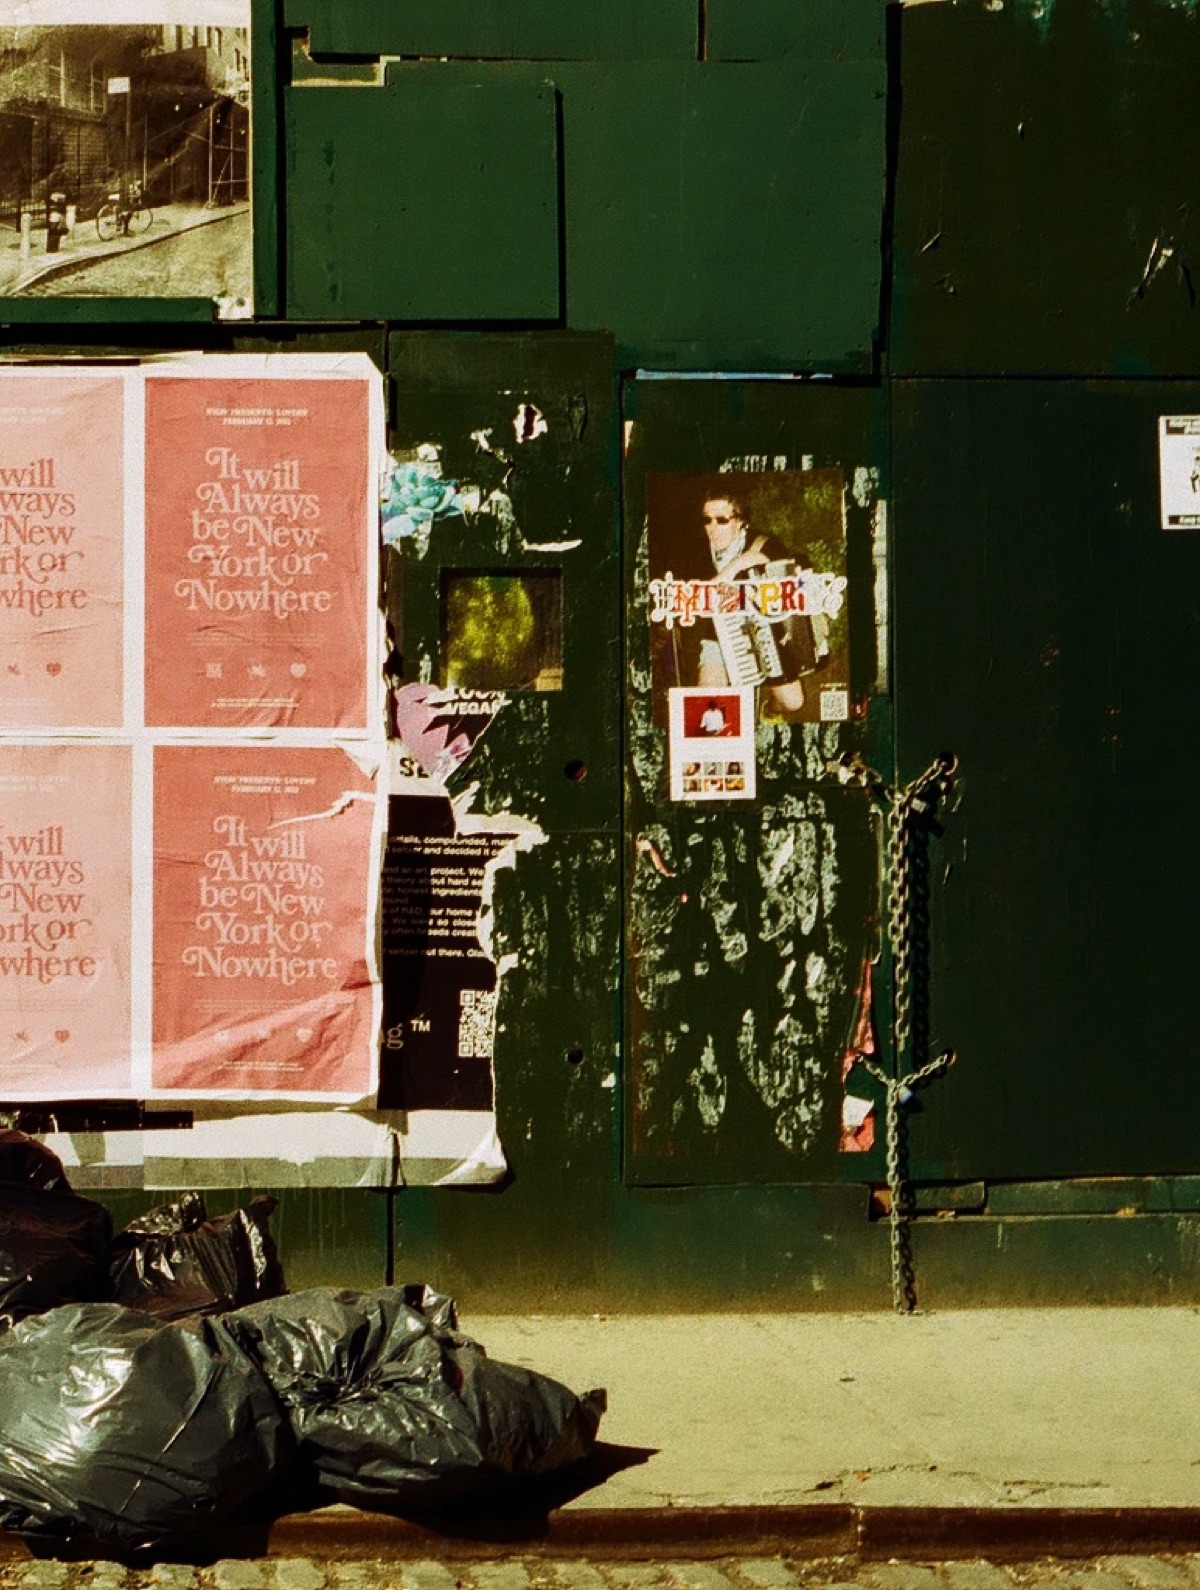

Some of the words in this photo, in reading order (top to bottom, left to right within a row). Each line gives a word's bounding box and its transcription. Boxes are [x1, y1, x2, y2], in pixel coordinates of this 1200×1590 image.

[0, 458, 55, 488] will
[205, 448, 241, 479] It
[243, 459, 301, 490] will
[196, 483, 320, 522] Always
[192, 510, 232, 540] be
[233, 516, 320, 548] New
[39, 551, 85, 573] or
[188, 545, 293, 586] York
[281, 552, 328, 575] or
[174, 579, 332, 619] Nowhere
[7, 826, 64, 856] will
[213, 815, 250, 847] It
[250, 829, 306, 859] will
[423, 846, 442, 855] and
[443, 846, 482, 856] decided
[204, 851, 324, 889] Always
[430, 867, 466, 877] project.
[447, 876, 469, 886] hard
[199, 878, 239, 908] be
[241, 884, 326, 915] New
[46, 919, 94, 941] or
[196, 913, 302, 952] York
[290, 920, 333, 944] or
[182, 946, 338, 986] Nowhere
